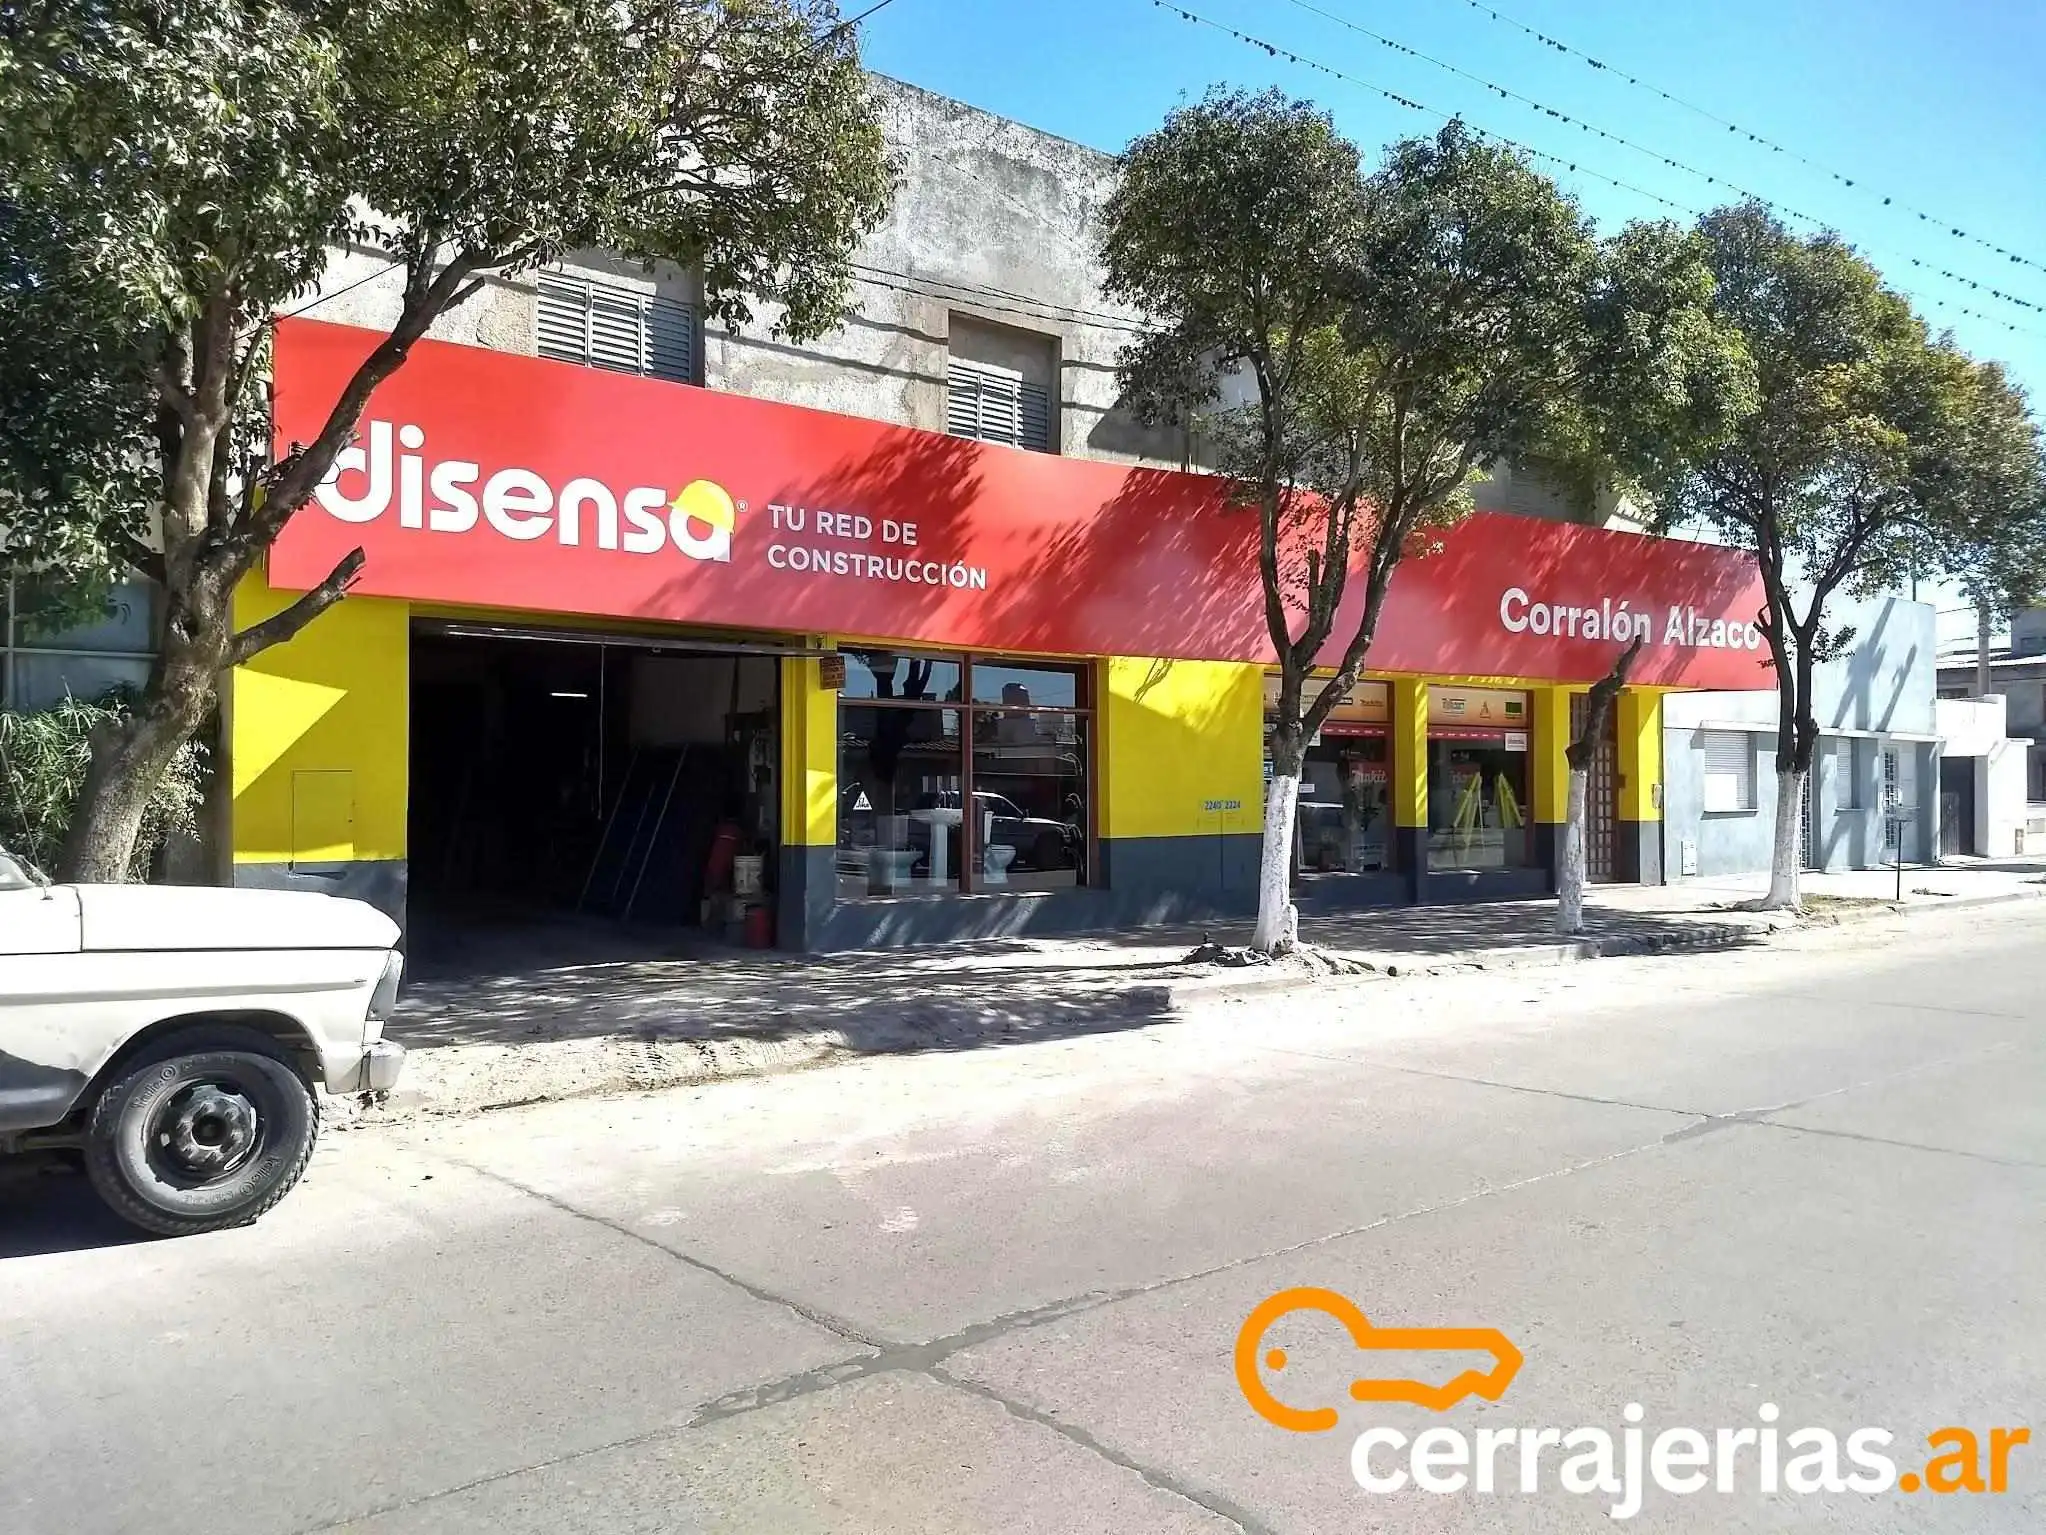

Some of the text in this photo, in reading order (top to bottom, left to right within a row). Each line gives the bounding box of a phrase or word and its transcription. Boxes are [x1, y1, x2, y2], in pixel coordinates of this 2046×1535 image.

[314, 419, 734, 563] disensa
[767, 504, 918, 547] TU RED DE
[767, 544, 987, 590] CONSTRUCCIÓN
[1500, 587, 1761, 650] Corralón Alzaco
